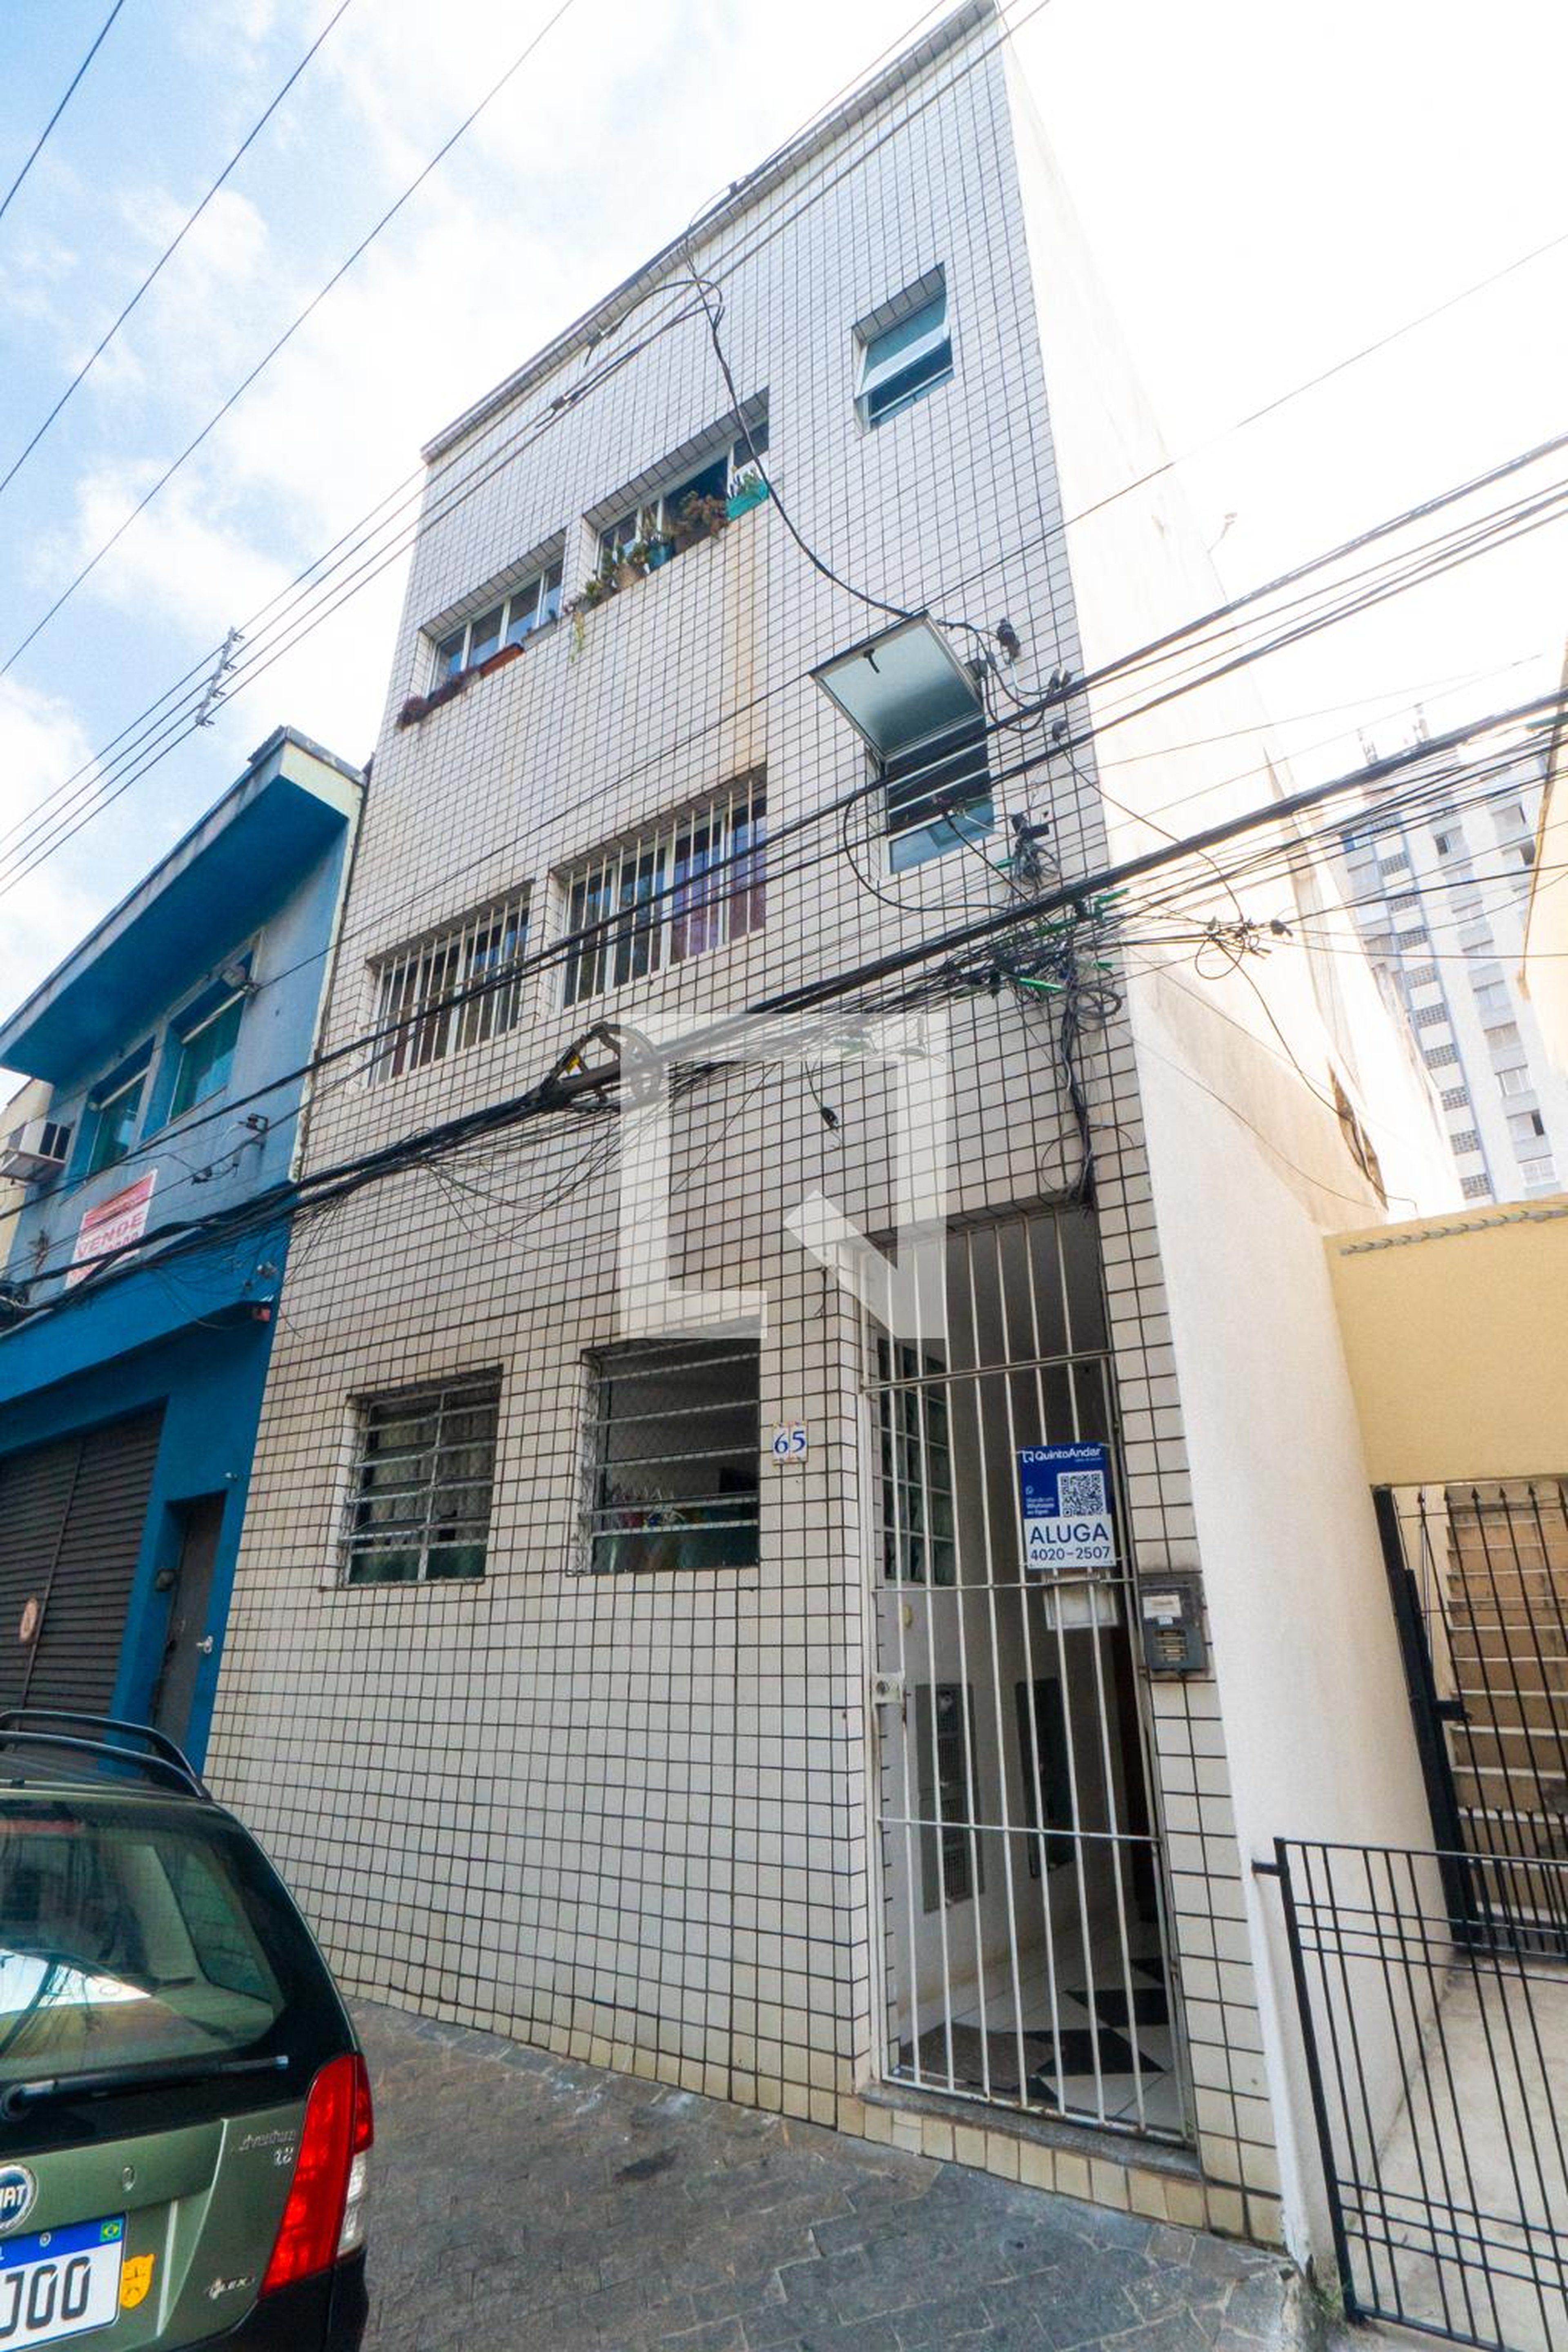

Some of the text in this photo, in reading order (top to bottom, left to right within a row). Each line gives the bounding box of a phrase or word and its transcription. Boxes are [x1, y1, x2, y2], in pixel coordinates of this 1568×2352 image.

[774, 1430, 806, 1453] 65
[1035, 1447, 1101, 1461] QuintoAndar
[1030, 1523, 1109, 1544] ALUGA
[1030, 1546, 1110, 1561] 4020-2507
